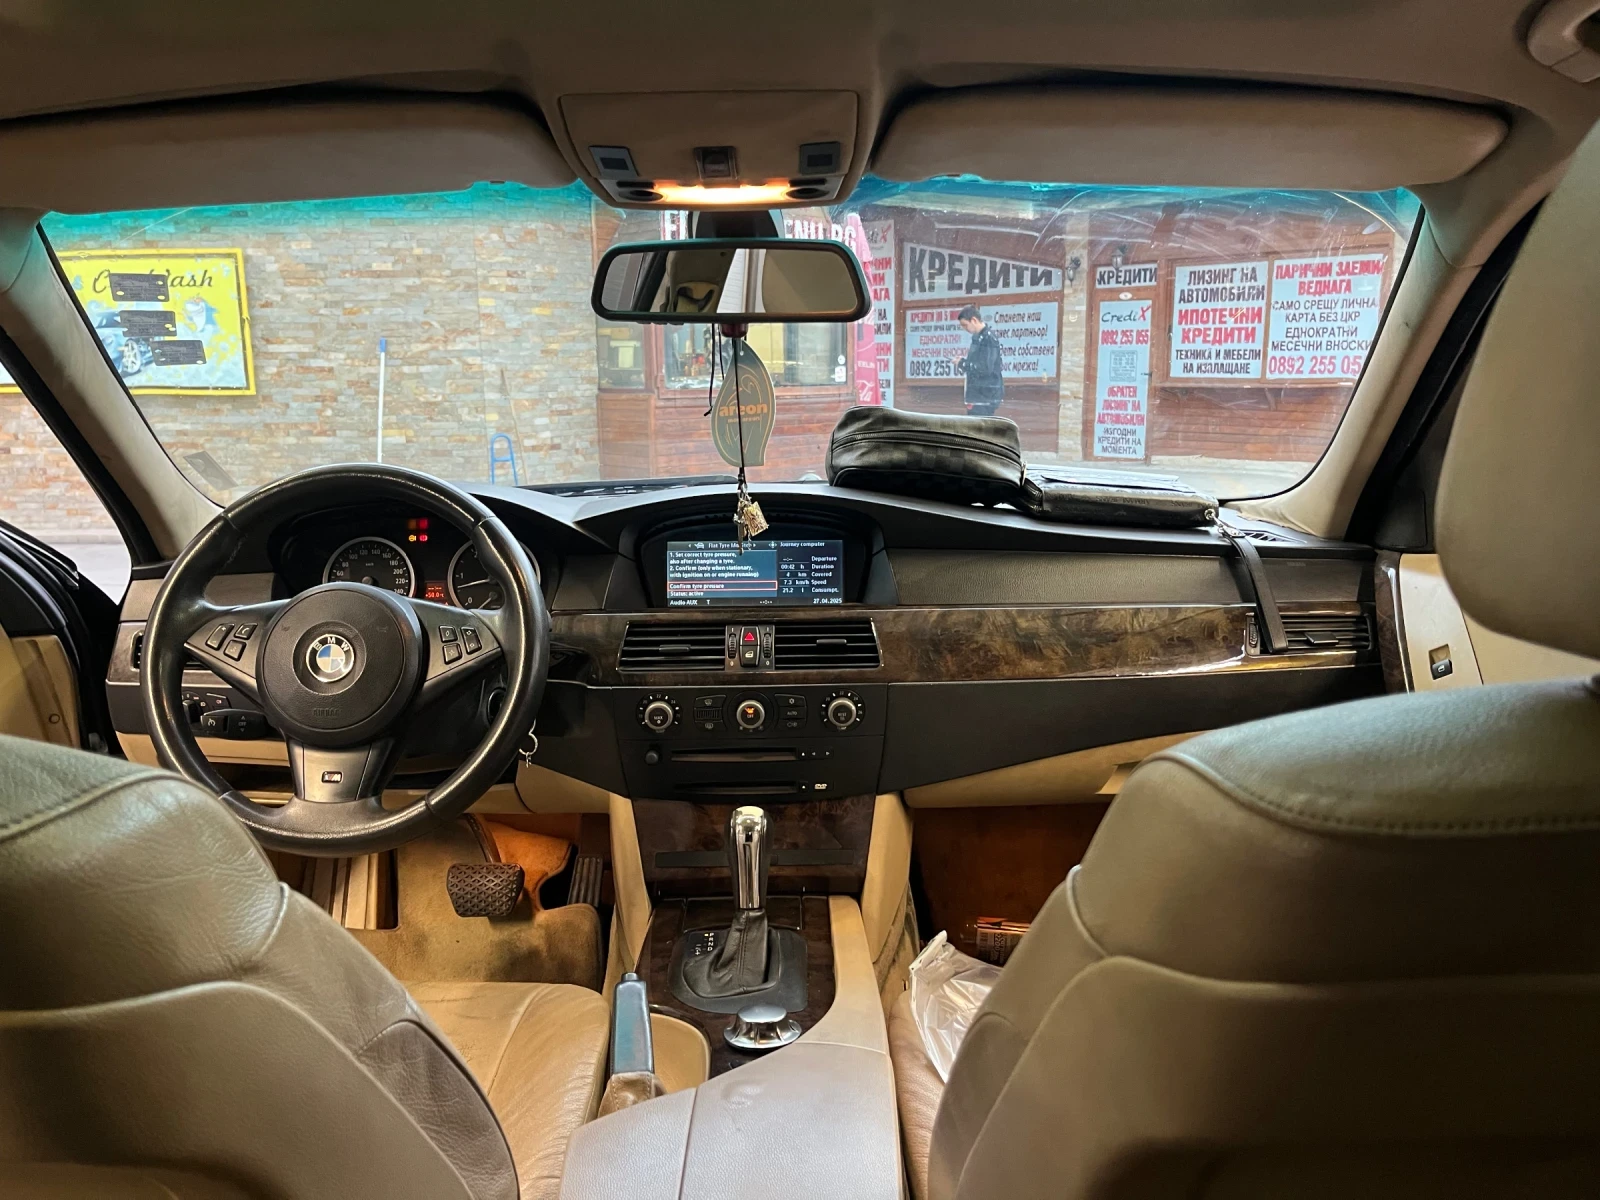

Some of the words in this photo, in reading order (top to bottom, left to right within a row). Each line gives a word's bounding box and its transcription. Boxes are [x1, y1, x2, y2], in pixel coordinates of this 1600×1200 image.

[909, 246, 1052, 294] КРЕДИТИ
[1097, 267, 1157, 285] КРЕДИТИ
[1188, 268, 1237, 286] ЛИЗИНГ
[1240, 267, 1258, 282] НА
[1275, 264, 1332, 280] ПАРИЧНИ
[1178, 285, 1265, 304] АВТОМОБИЛИ
[1298, 279, 1352, 296] ВЕДНАГА
[1272, 301, 1301, 311] САМО
[1304, 299, 1339, 310] СРЕЩУ
[1341, 298, 1376, 308] ЛИЧНА
[994, 312, 1025, 323] Станете
[1178, 307, 1262, 325] ИПОТЕЧНИ
[1285, 313, 1316, 323] КАРТА
[1320, 312, 1338, 322] БЕЗ
[1340, 312, 1360, 324] ЦКР
[1181, 326, 1256, 346] КРЕДИТИ
[1286, 327, 1358, 340] ЕДНОКРАТНИ
[1272, 341, 1322, 351] МЕСЕЧНИ
[1176, 349, 1211, 361] ТЕХНИКА
[1215, 350, 1220, 360] И
[1223, 349, 1261, 361] МЕБЕЛИ
[910, 360, 931, 376] 0892
[934, 360, 951, 376] 255
[1183, 363, 1194, 374] НА
[1269, 356, 1303, 375] 0892
[1309, 356, 1336, 374] 255
[719, 403, 768, 417] areon
[1098, 436, 1130, 445] КРЕДИТИ
[1102, 445, 1137, 455] МОМЕНТА
[313, 636, 350, 652] BMW
